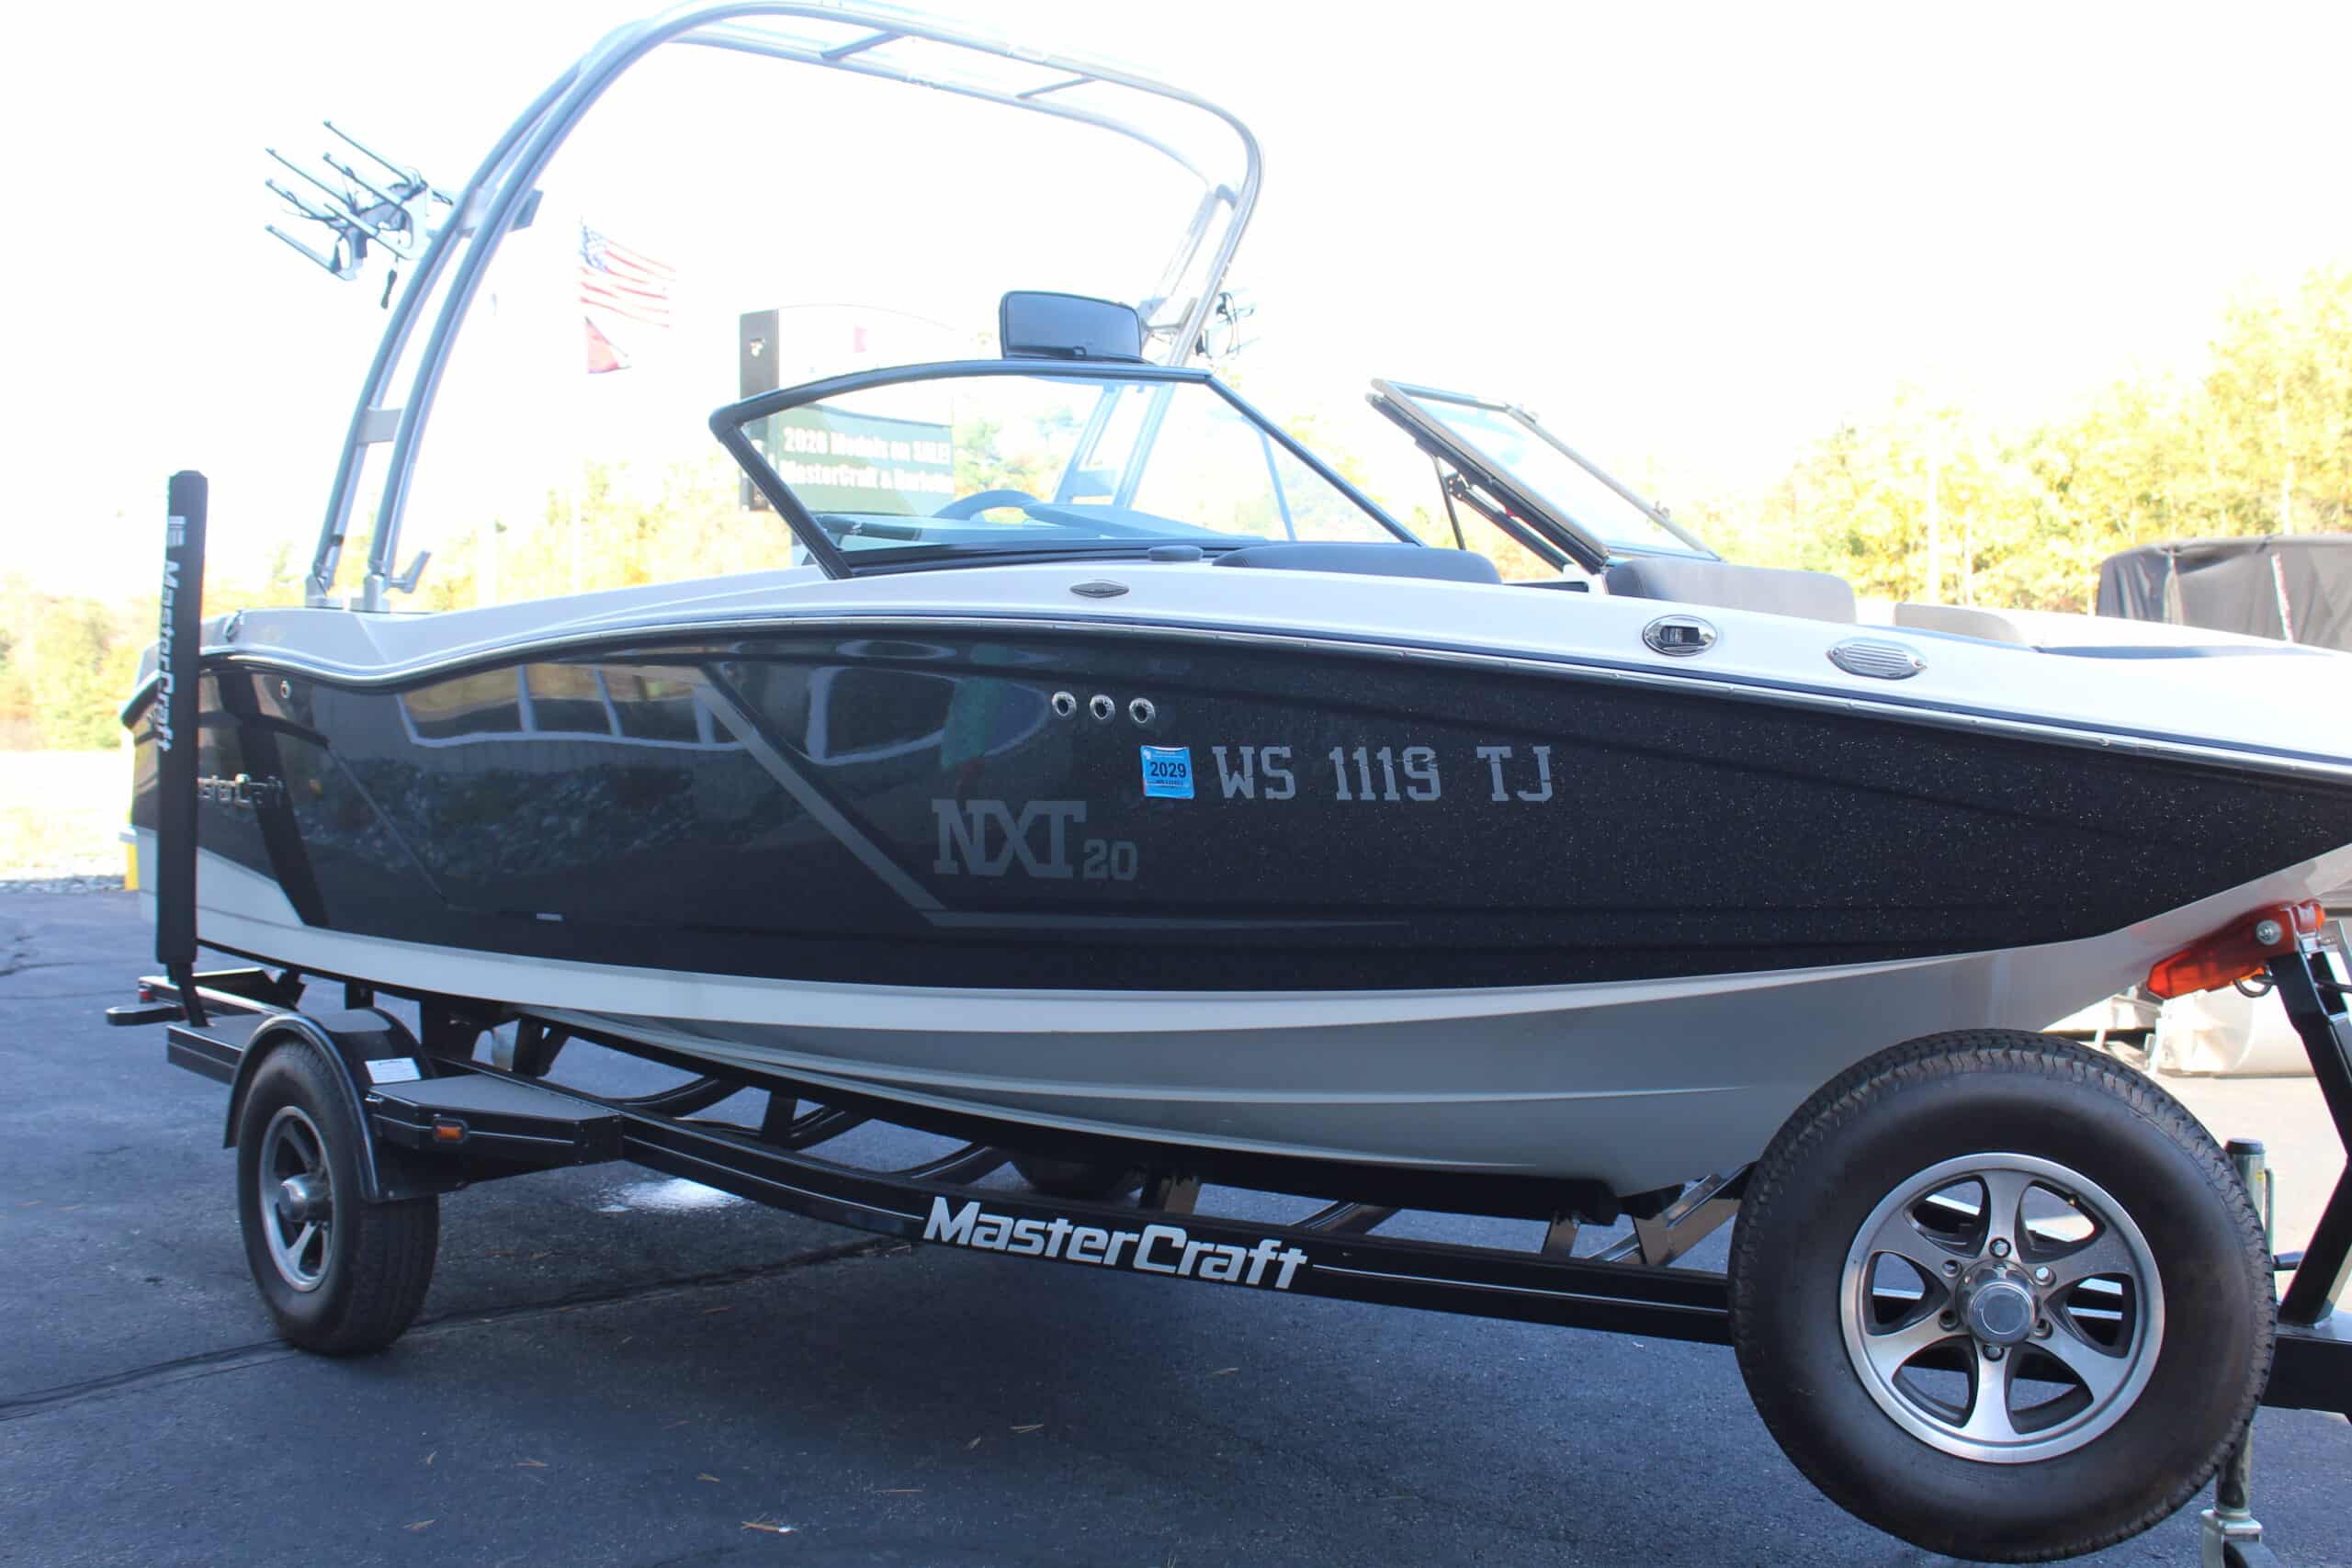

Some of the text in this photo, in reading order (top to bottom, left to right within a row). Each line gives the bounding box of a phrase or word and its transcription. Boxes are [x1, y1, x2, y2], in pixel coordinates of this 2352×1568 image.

[155, 560, 180, 751] MasterCraft
[1149, 761, 1187, 778] 2029
[1212, 745, 1296, 800] WS
[1476, 745, 1554, 802] TJ
[931, 798, 1138, 881] NXT 20
[922, 1195, 1308, 1290] MasterCraft
